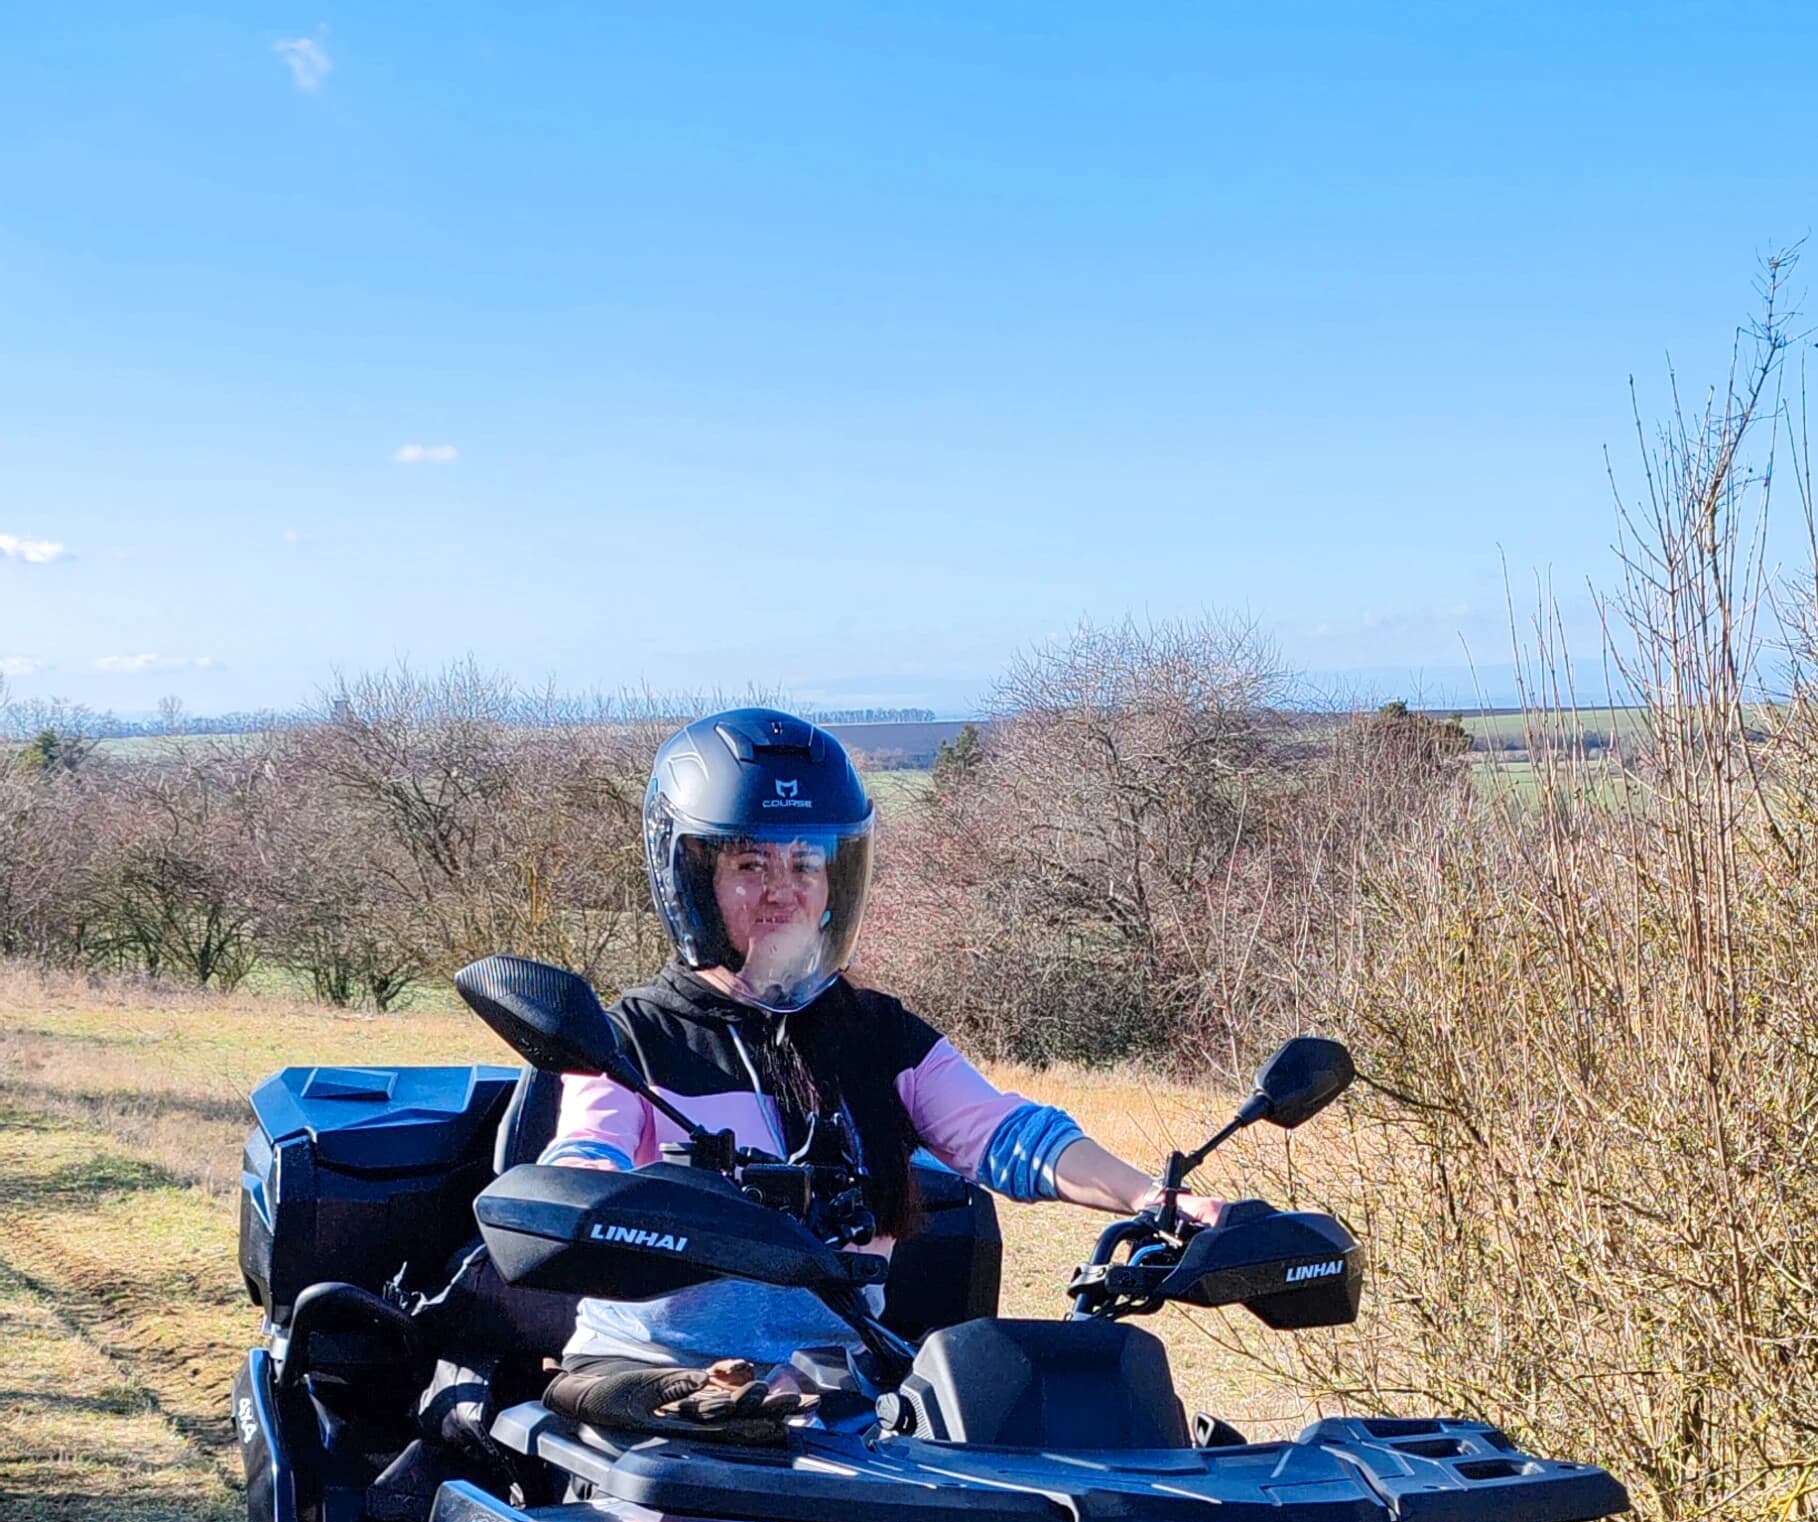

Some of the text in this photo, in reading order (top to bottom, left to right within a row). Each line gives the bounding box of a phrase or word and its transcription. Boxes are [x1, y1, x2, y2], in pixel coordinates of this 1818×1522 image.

[762, 799, 813, 808] COURSE
[590, 1223, 688, 1252] LINHAI
[1285, 1260, 1344, 1282] LINHAI
